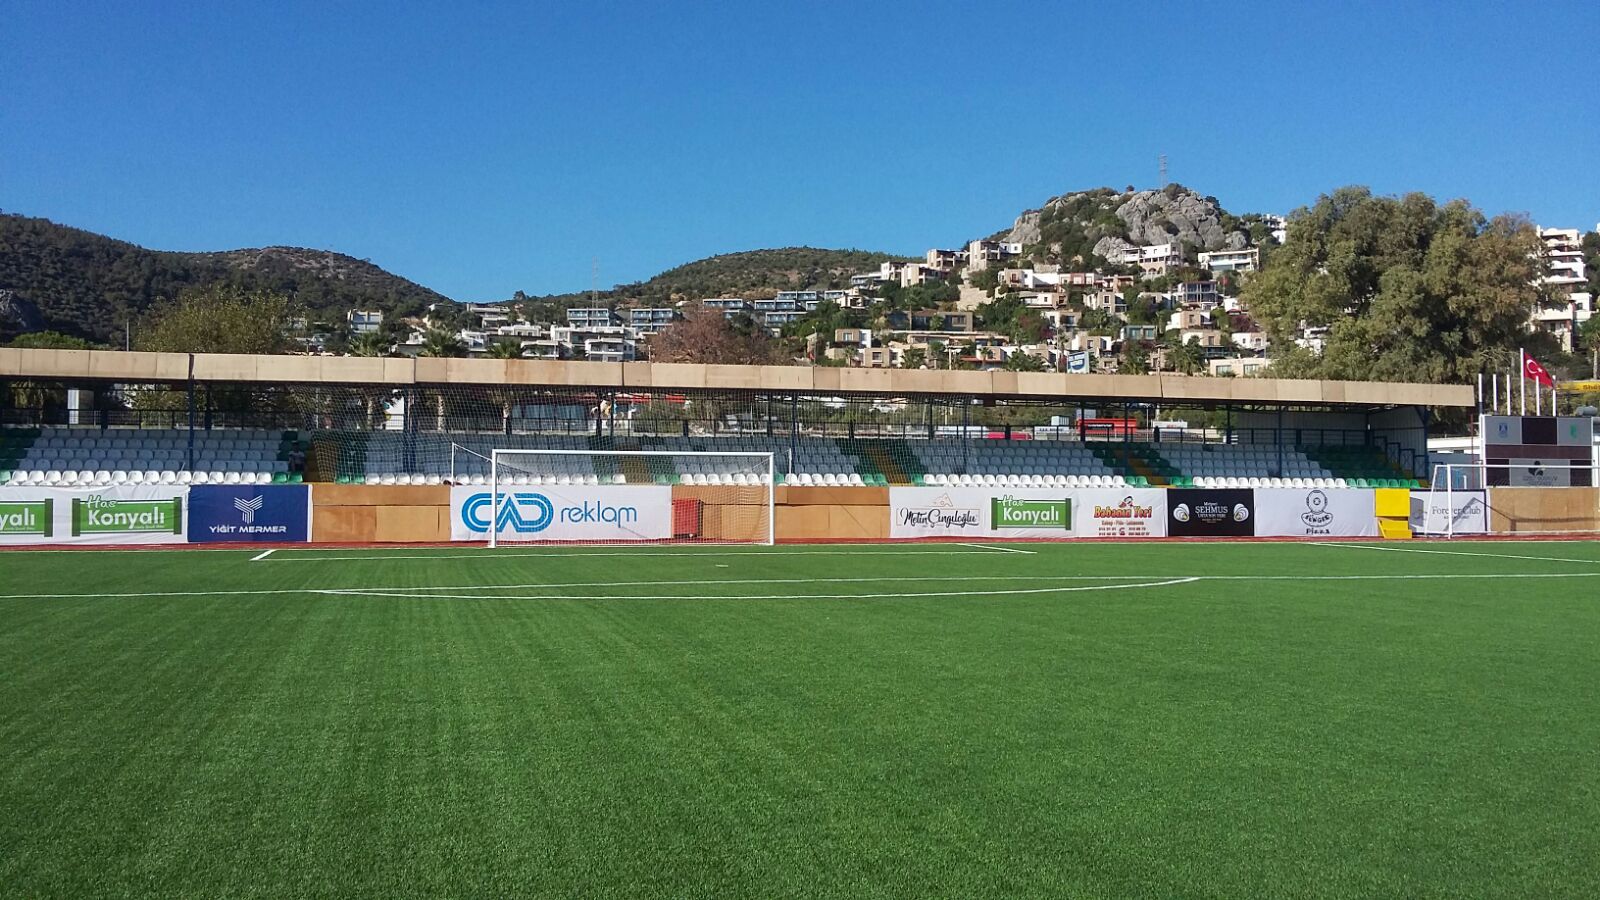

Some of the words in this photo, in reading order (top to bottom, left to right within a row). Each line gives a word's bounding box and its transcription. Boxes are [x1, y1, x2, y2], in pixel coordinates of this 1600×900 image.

[86, 494, 117, 508] Has
[1003, 494, 1024, 507] Has
[561, 500, 637, 528] reklam
[900, 507, 928, 527] Metin
[1003, 505, 1059, 525] Konyalı
[1133, 505, 1152, 518] Yeri
[1432, 506, 1461, 515] Foreer
[1463, 505, 1481, 515] Club
[88, 506, 165, 530] Konyalı
[239, 525, 287, 534] MERMER
